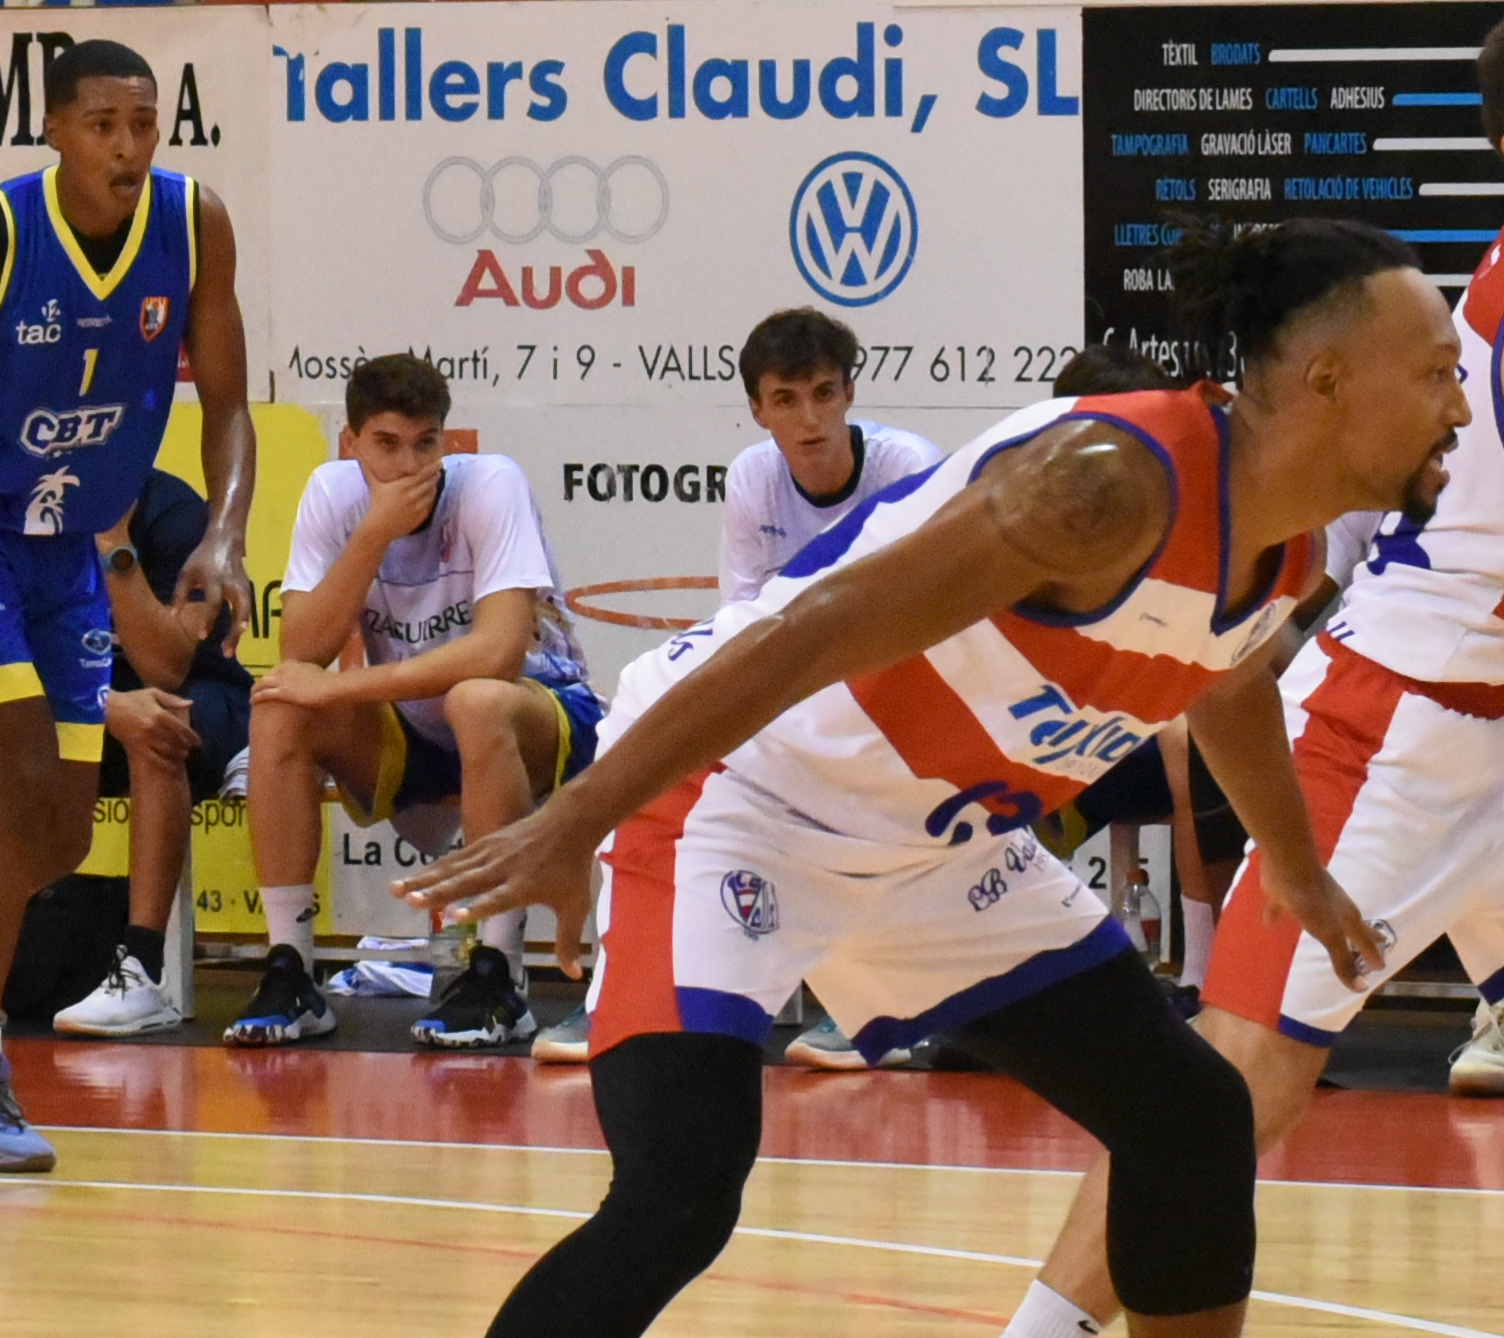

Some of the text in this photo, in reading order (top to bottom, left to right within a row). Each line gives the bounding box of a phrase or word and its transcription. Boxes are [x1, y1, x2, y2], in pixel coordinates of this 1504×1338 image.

[1162, 40, 1261, 66] TÈXTIL BRODATS
[603, 21, 939, 133] Claudi,
[975, 27, 1080, 119] SL
[1134, 86, 1385, 112] DIRECTORIS DE LAMES CARTELLS ADHESIUS
[1111, 128, 1368, 157] TAMPOGRAFIA GRAVACIÓ LÀSER PANCARTES
[1208, 177, 1272, 201] SERIGRAFIA
[1284, 175, 1345, 201] RETOLACIÓ
[1346, 177, 1360, 201] DE
[1361, 177, 1414, 201] VEHICLES
[1114, 224, 1160, 247] LLETRES
[454, 248, 636, 311] Audi
[1124, 269, 1155, 292] ROBA
[15, 319, 62, 345] tac
[78, 348, 99, 397] 1
[516, 346, 535, 384] 7
[552, 345, 560, 383] i
[576, 345, 597, 383] 9
[642, 345, 738, 382] VALLS
[929, 345, 997, 384] 612
[19, 404, 126, 457] CBT
[342, 833, 381, 867] La
